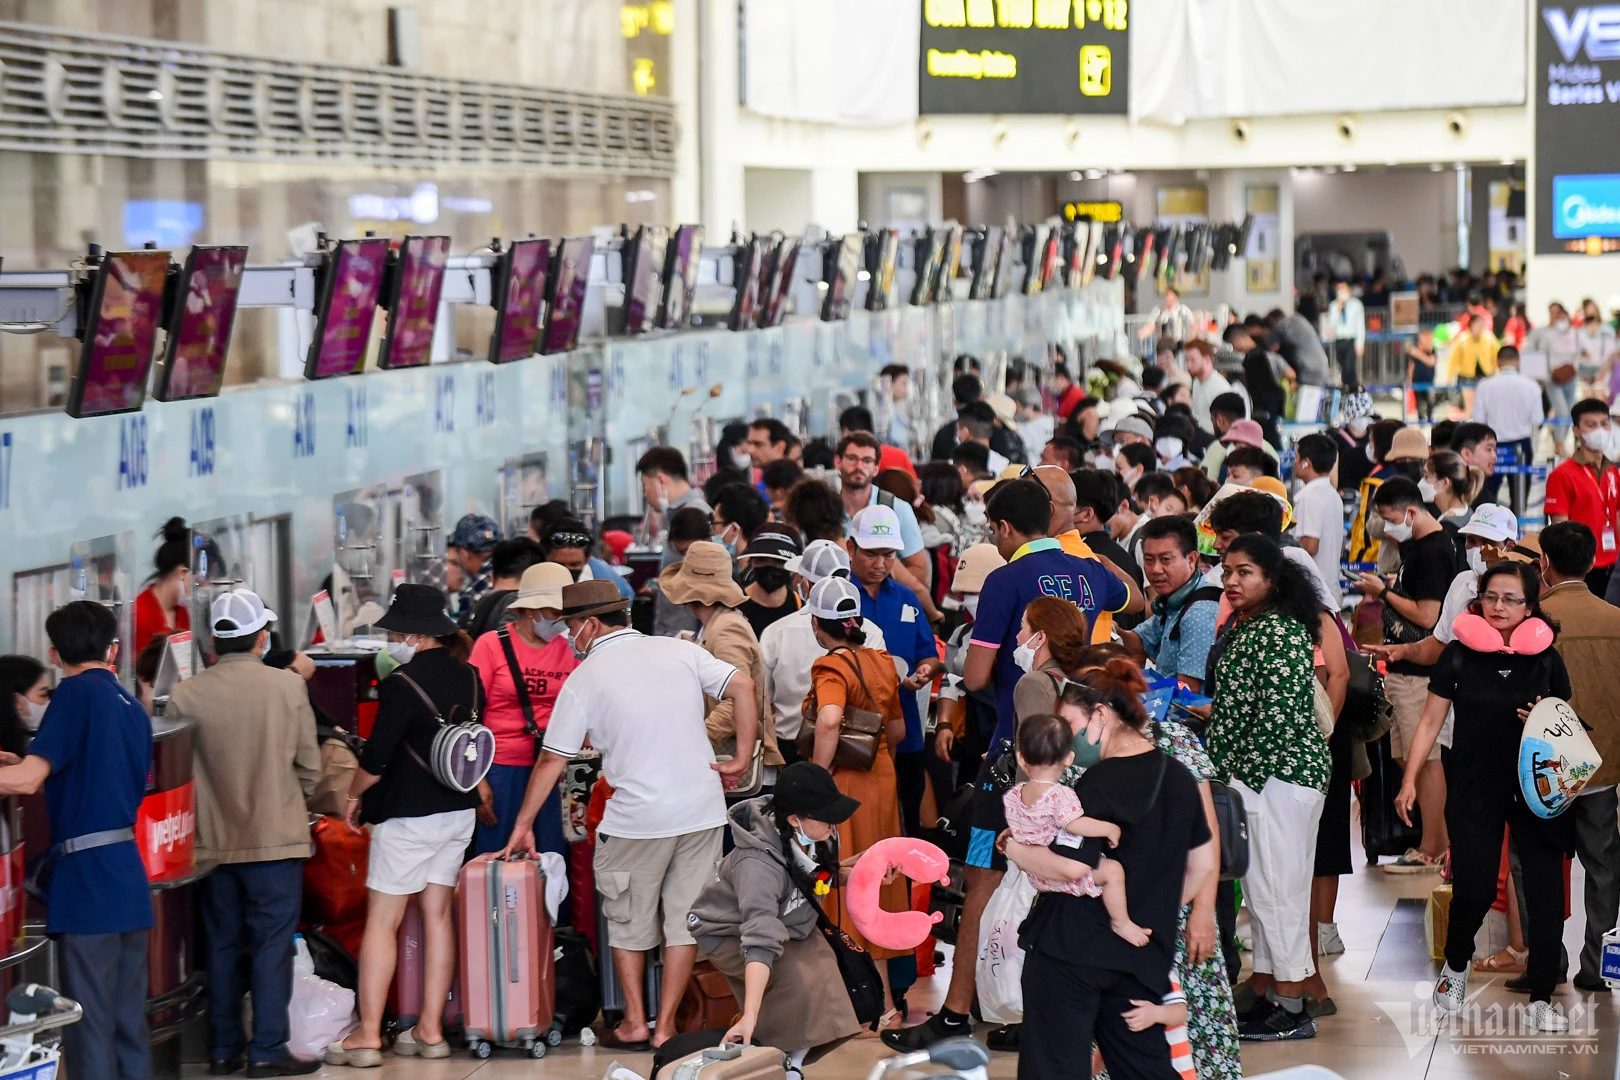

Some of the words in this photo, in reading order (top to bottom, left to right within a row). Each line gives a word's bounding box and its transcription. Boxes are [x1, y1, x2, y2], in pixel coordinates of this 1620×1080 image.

[188, 408, 216, 478] A09
[294, 392, 316, 458] A10
[346, 386, 368, 447] A11
[117, 415, 148, 490] A08
[1038, 574, 1096, 611] SEA
